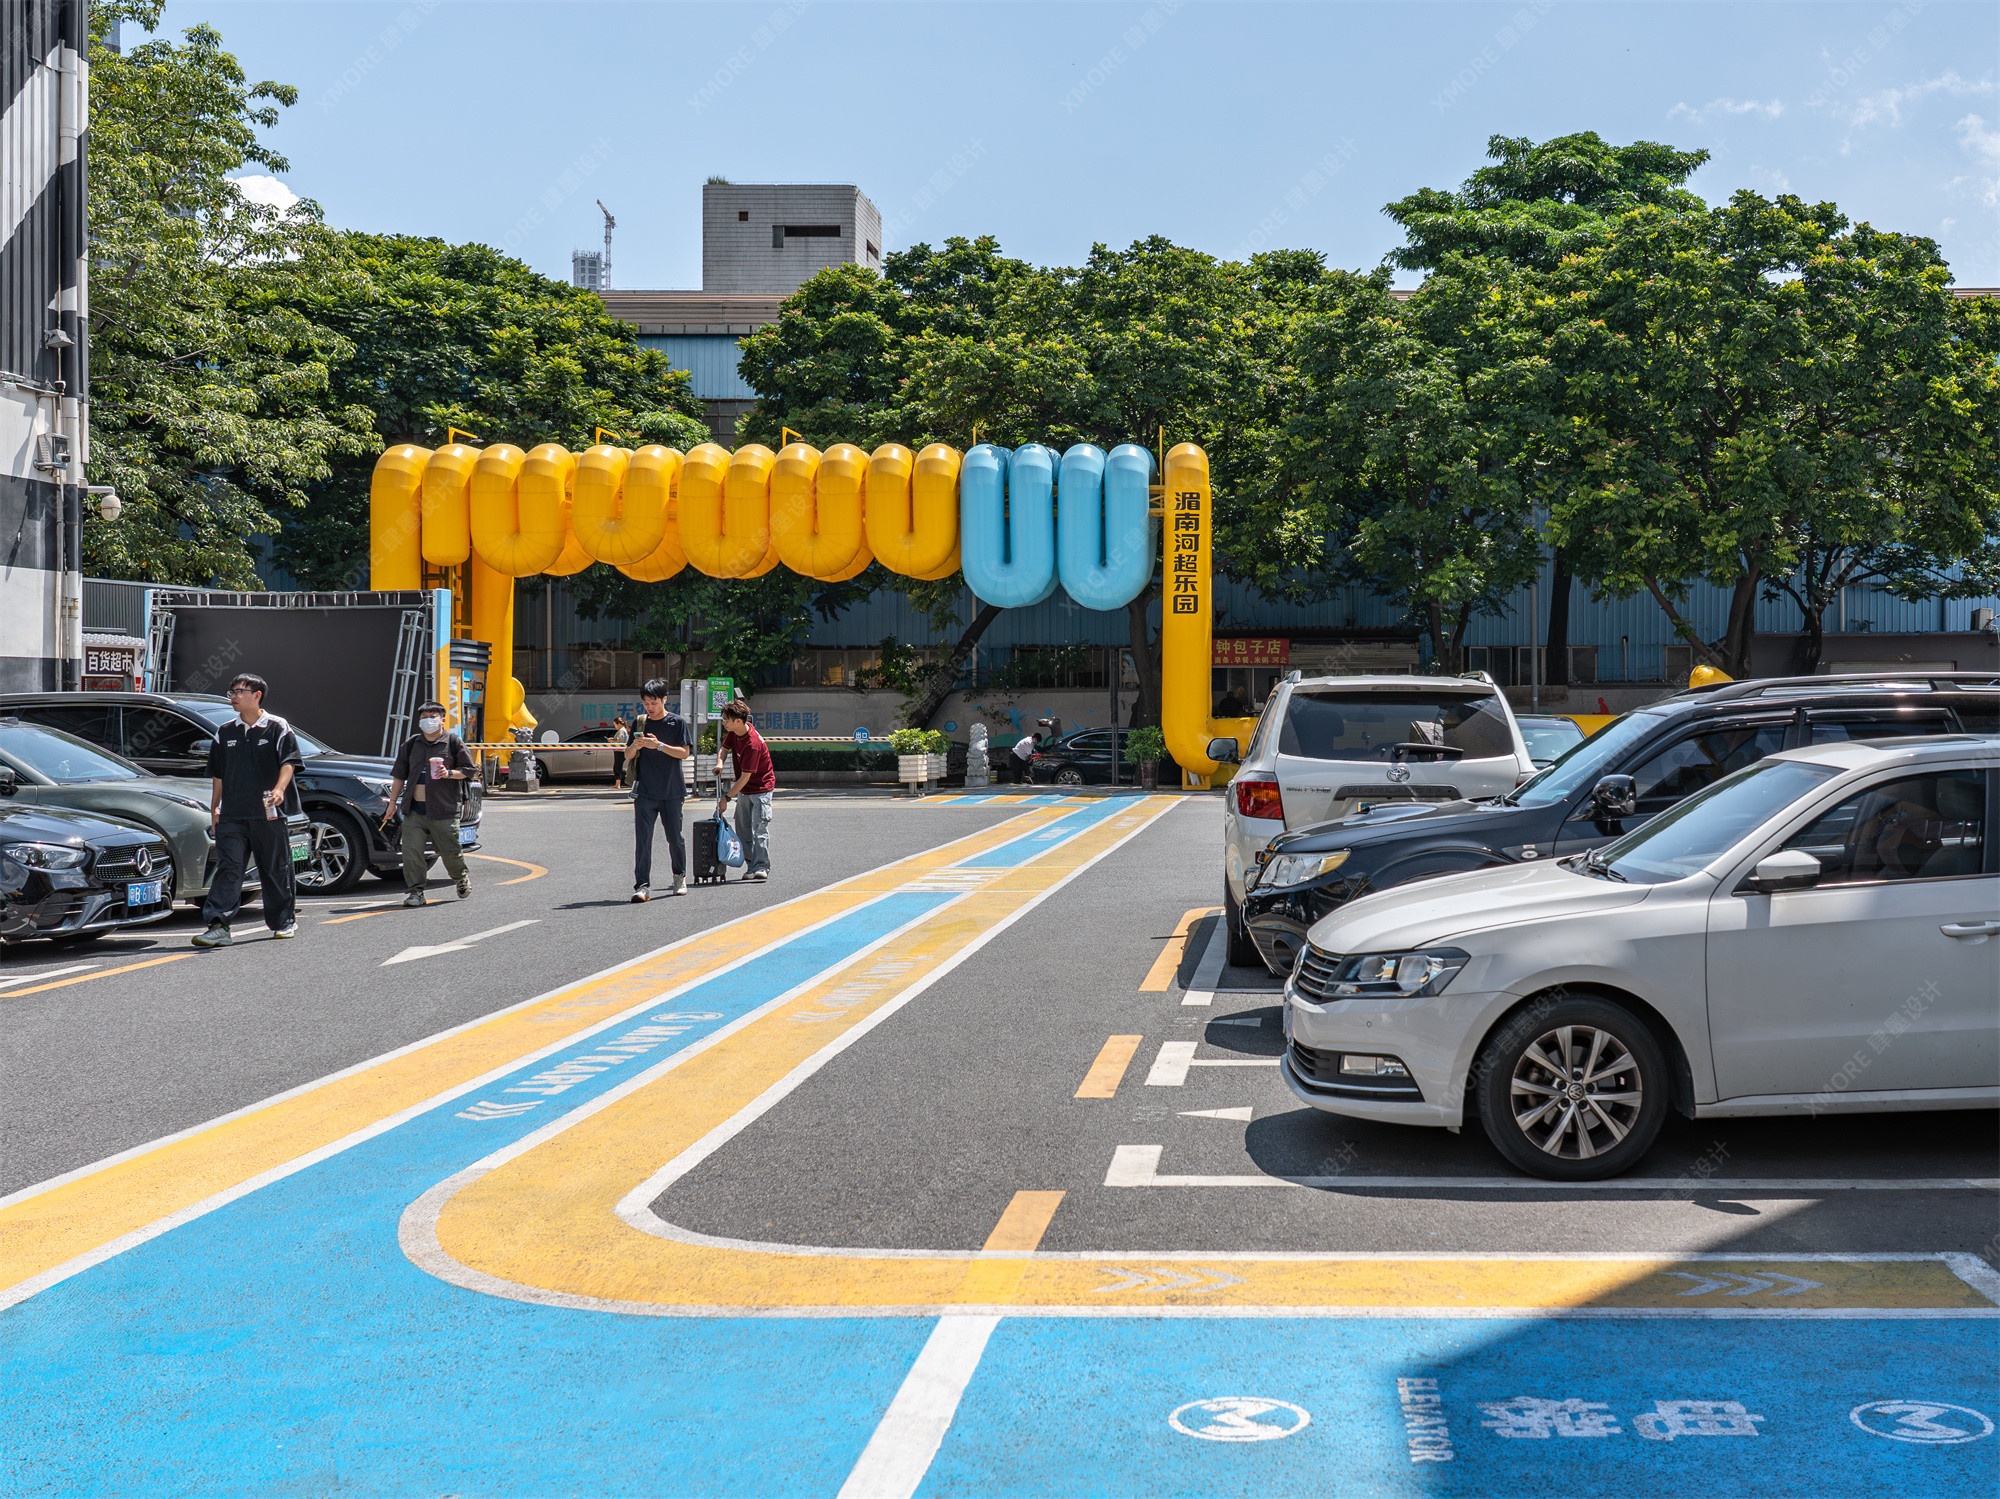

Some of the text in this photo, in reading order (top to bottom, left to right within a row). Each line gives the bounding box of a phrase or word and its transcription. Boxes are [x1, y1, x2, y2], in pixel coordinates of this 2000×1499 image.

[1172, 491, 1201, 615] 湄南河超乐园
[88, 650, 132, 672] 百货超市
[502, 1025, 694, 1095] MAY KART
[1395, 1377, 1455, 1463] ELEVATOR
